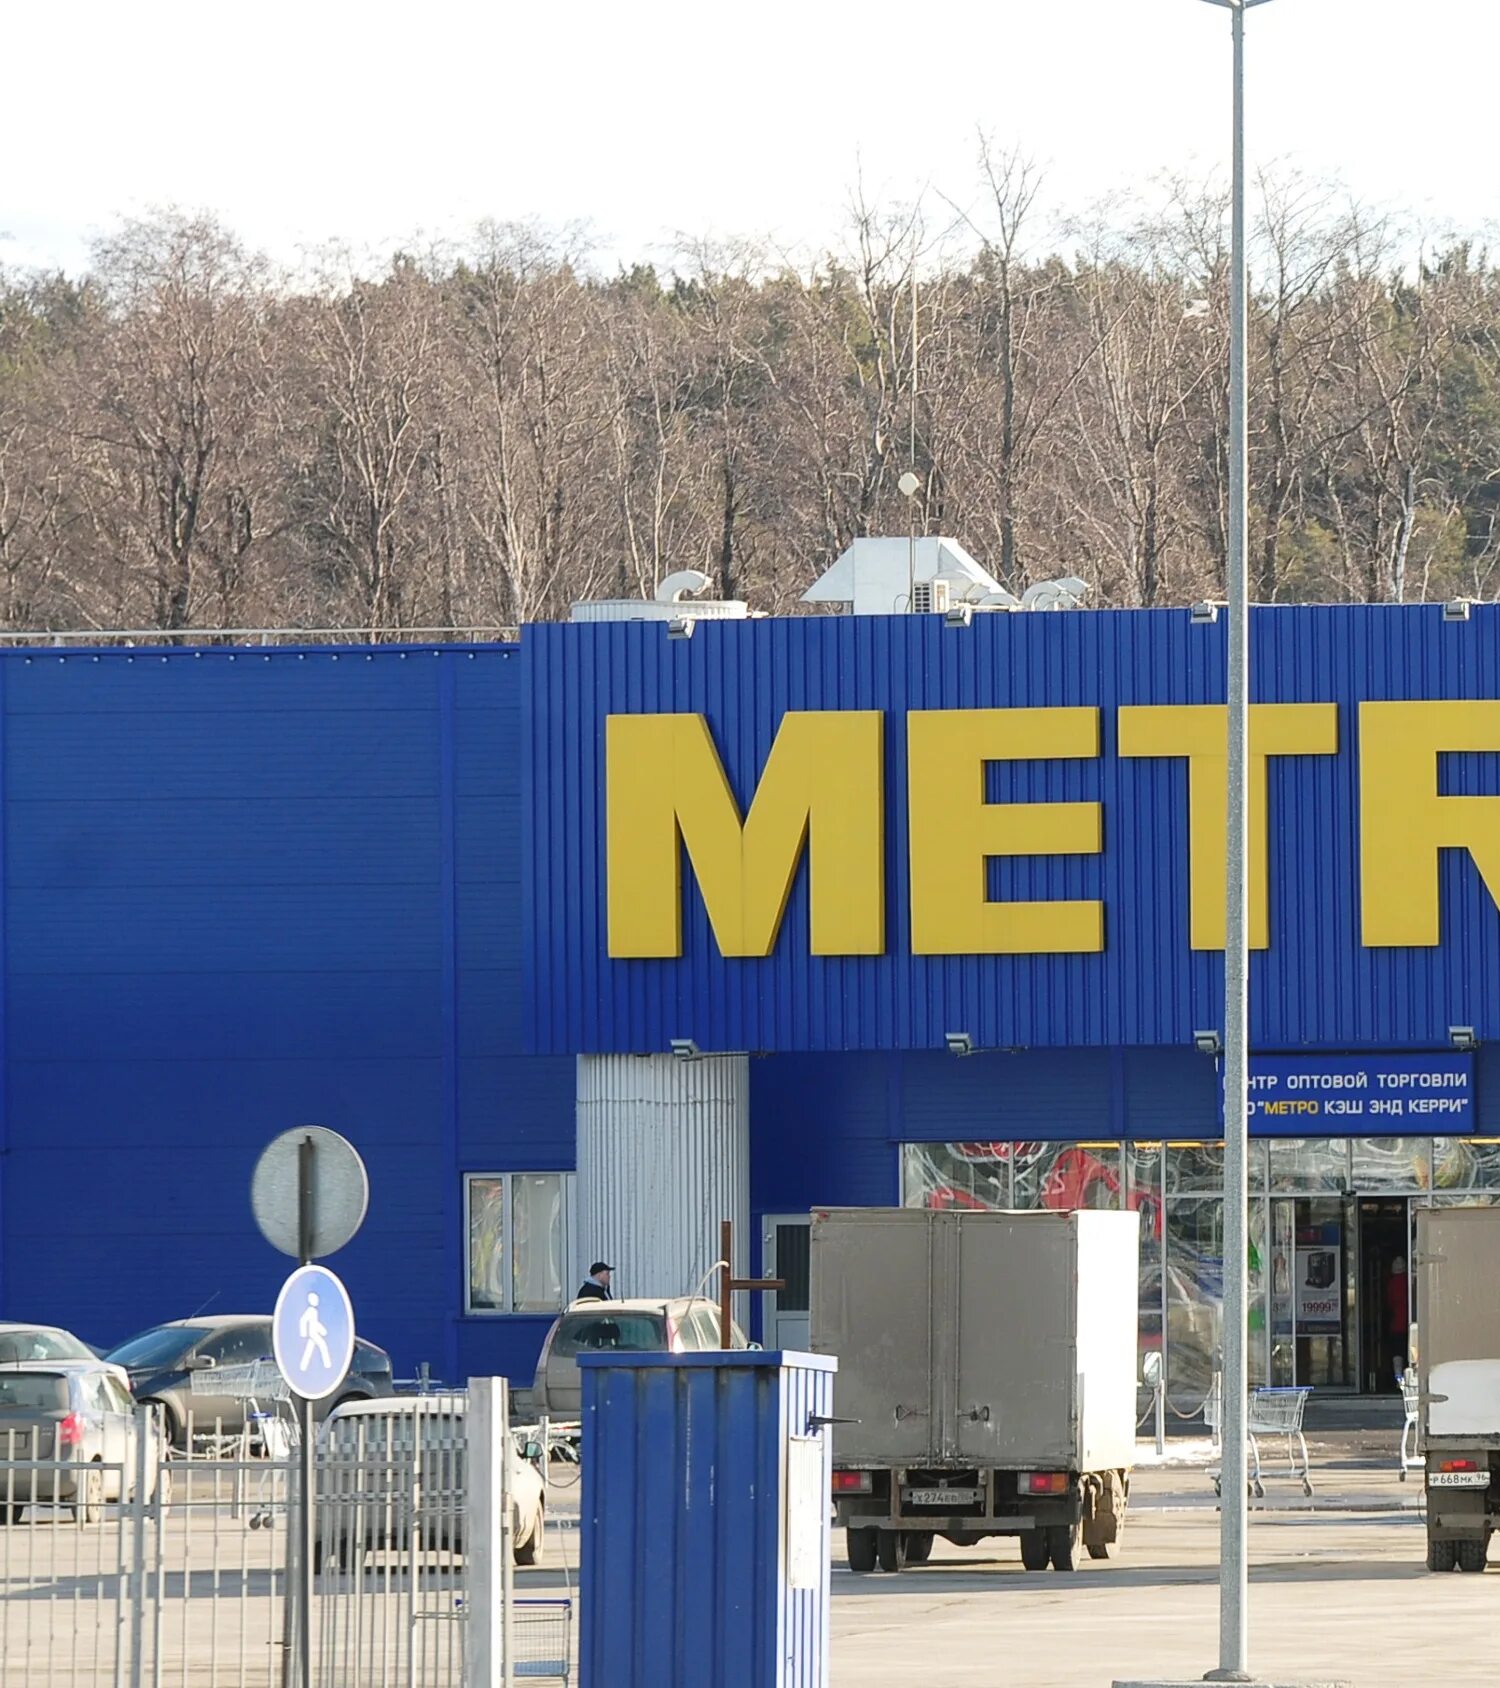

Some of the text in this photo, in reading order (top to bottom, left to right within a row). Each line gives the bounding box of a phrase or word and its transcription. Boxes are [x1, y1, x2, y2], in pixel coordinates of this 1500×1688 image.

[1223, 1072, 1467, 1090] НТР ОПТОВОЙ ТОРГОВЛИ
[1324, 1100, 1363, 1114] КЭШ
[1369, 1100, 1403, 1116] ЭНД
[1408, 1098, 1468, 1113] КЕРРИ"
